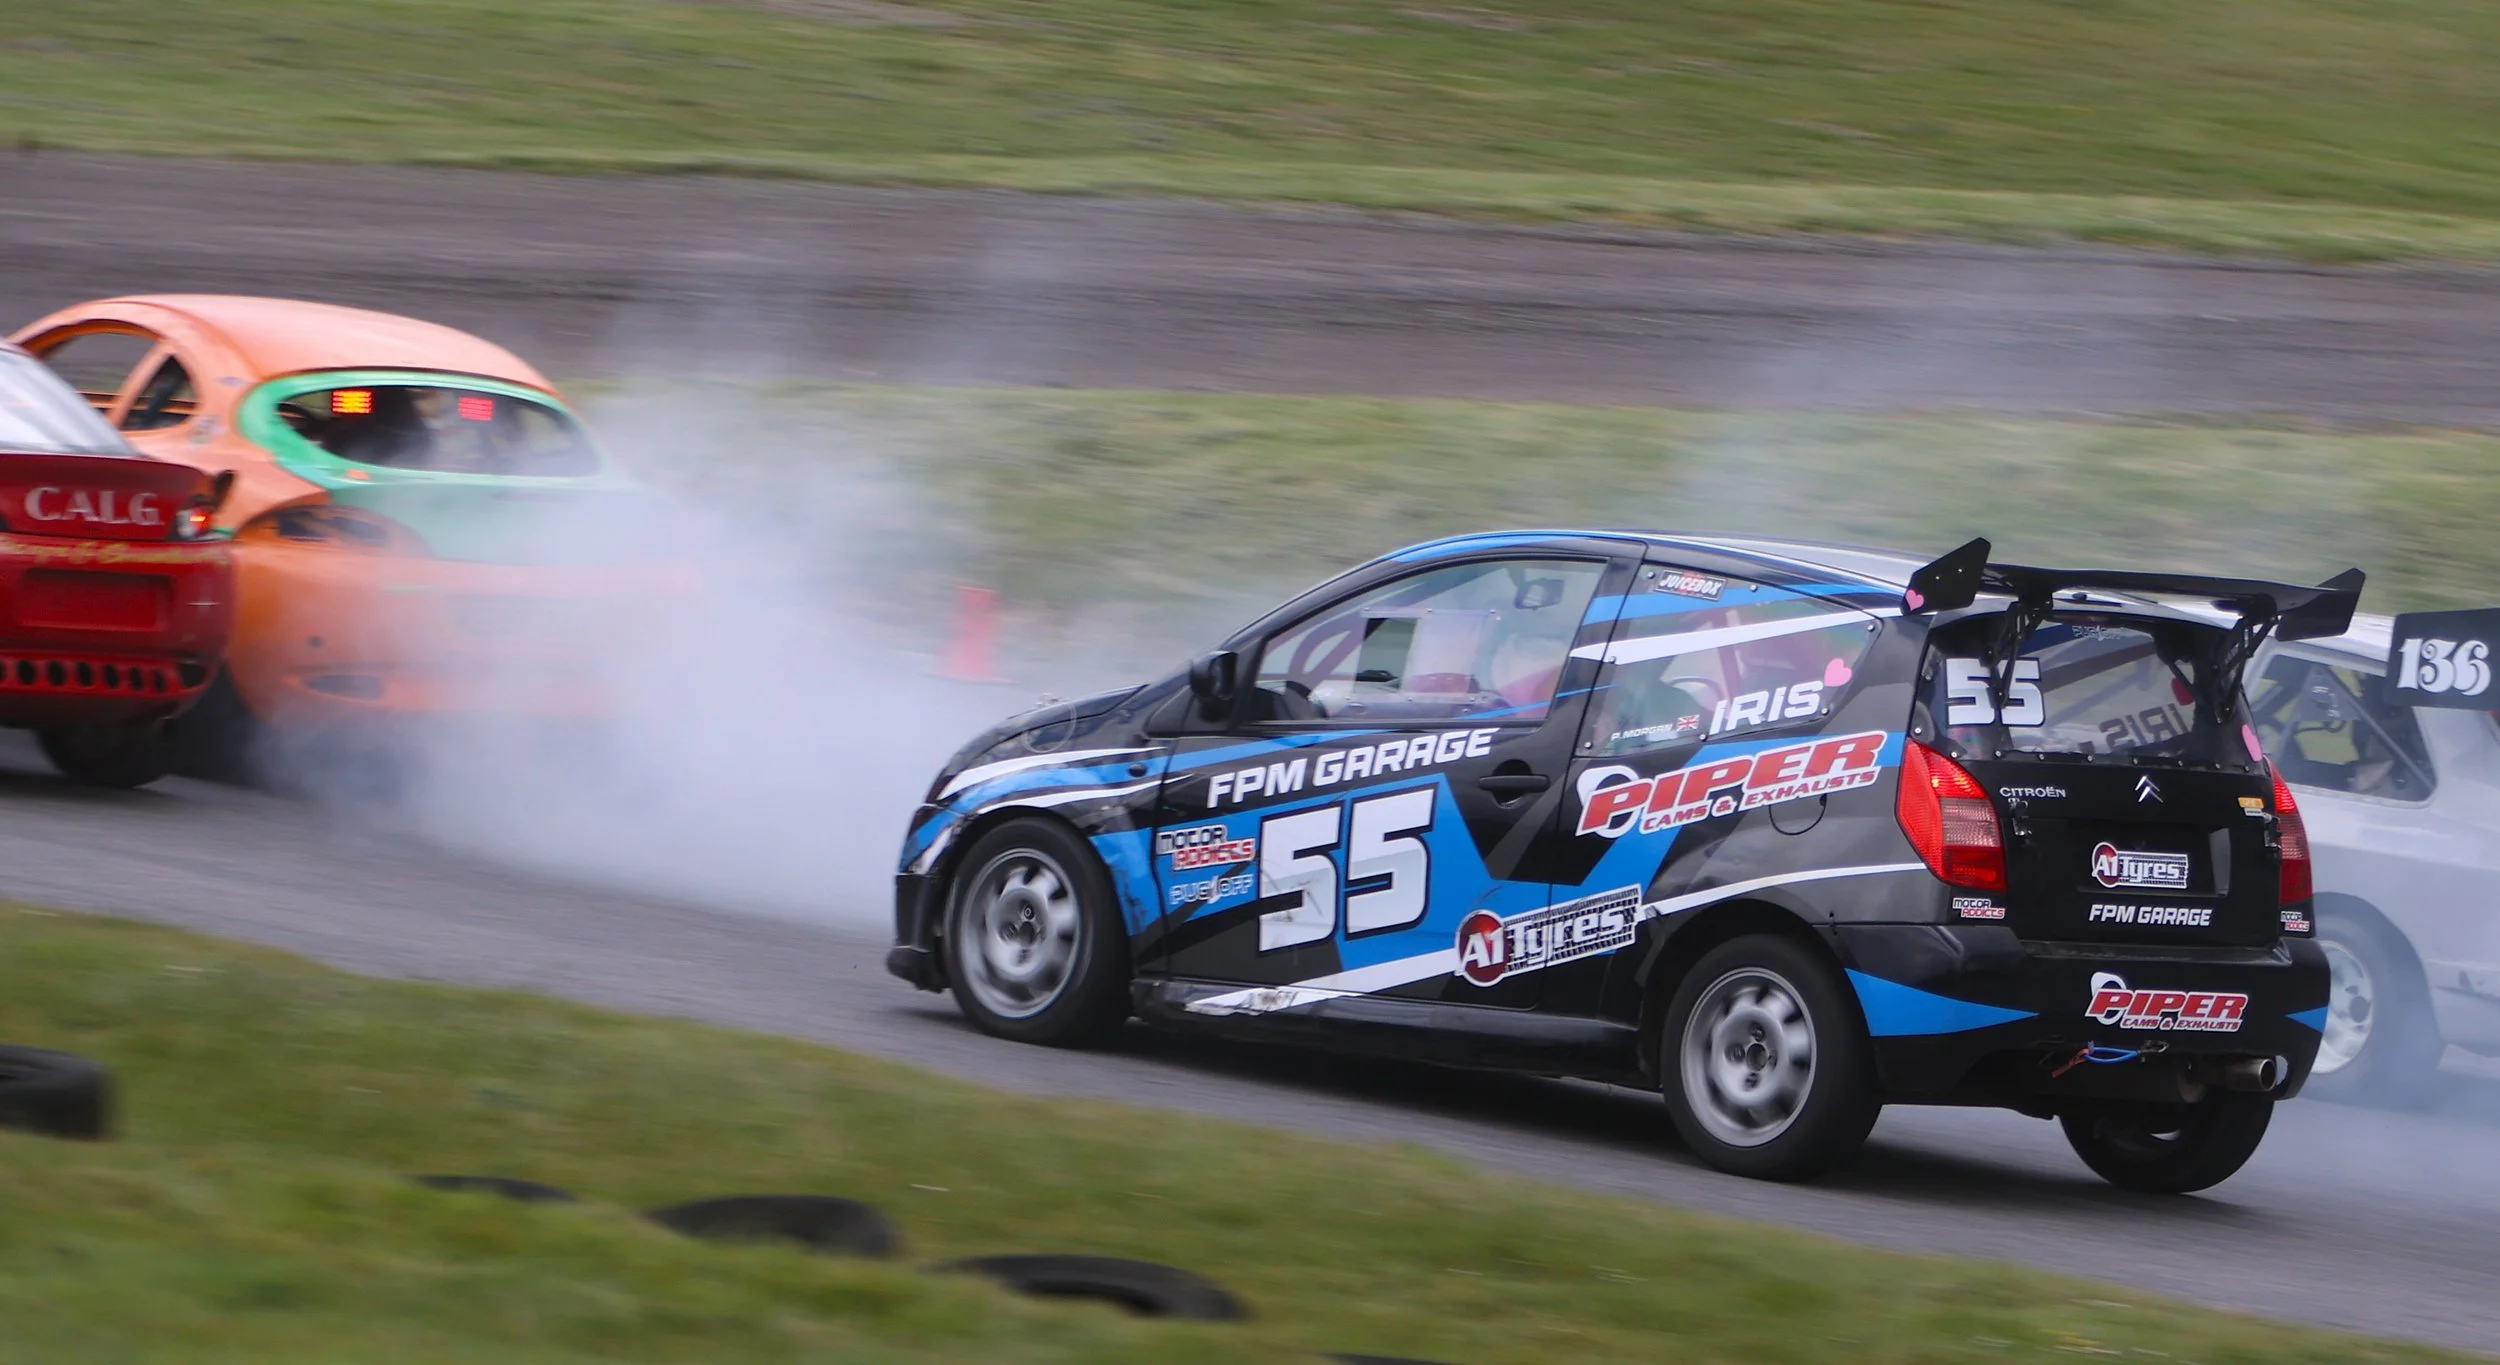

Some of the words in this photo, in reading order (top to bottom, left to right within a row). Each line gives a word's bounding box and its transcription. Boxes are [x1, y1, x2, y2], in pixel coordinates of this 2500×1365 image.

[1660, 574, 1721, 596] JUICEBOX
[2397, 638, 2491, 696] 136
[1709, 680, 1824, 735] IRIS
[1946, 657, 2045, 726] 55
[1207, 758, 1307, 808] FPM
[1312, 728, 1500, 788] GARAGE
[1578, 733, 1886, 834] PIPER
[1643, 803, 1706, 831] CAMS
[1715, 797, 1733, 815] &
[1744, 770, 1876, 806] EXHAUSTS
[2000, 785, 2066, 798] CITROËN
[1157, 824, 1228, 854] MOTOR
[1259, 786, 1436, 952] 55
[1953, 898, 1991, 909] MOTOR
[2089, 904, 2136, 923] FPM
[2137, 906, 2213, 926] GARAGE
[2088, 991, 2247, 1018] PIPER
[2123, 1017, 2158, 1028] CAMS
[2162, 1018, 2174, 1028] &
[2176, 1019, 2239, 1031] EXHAUSTS
